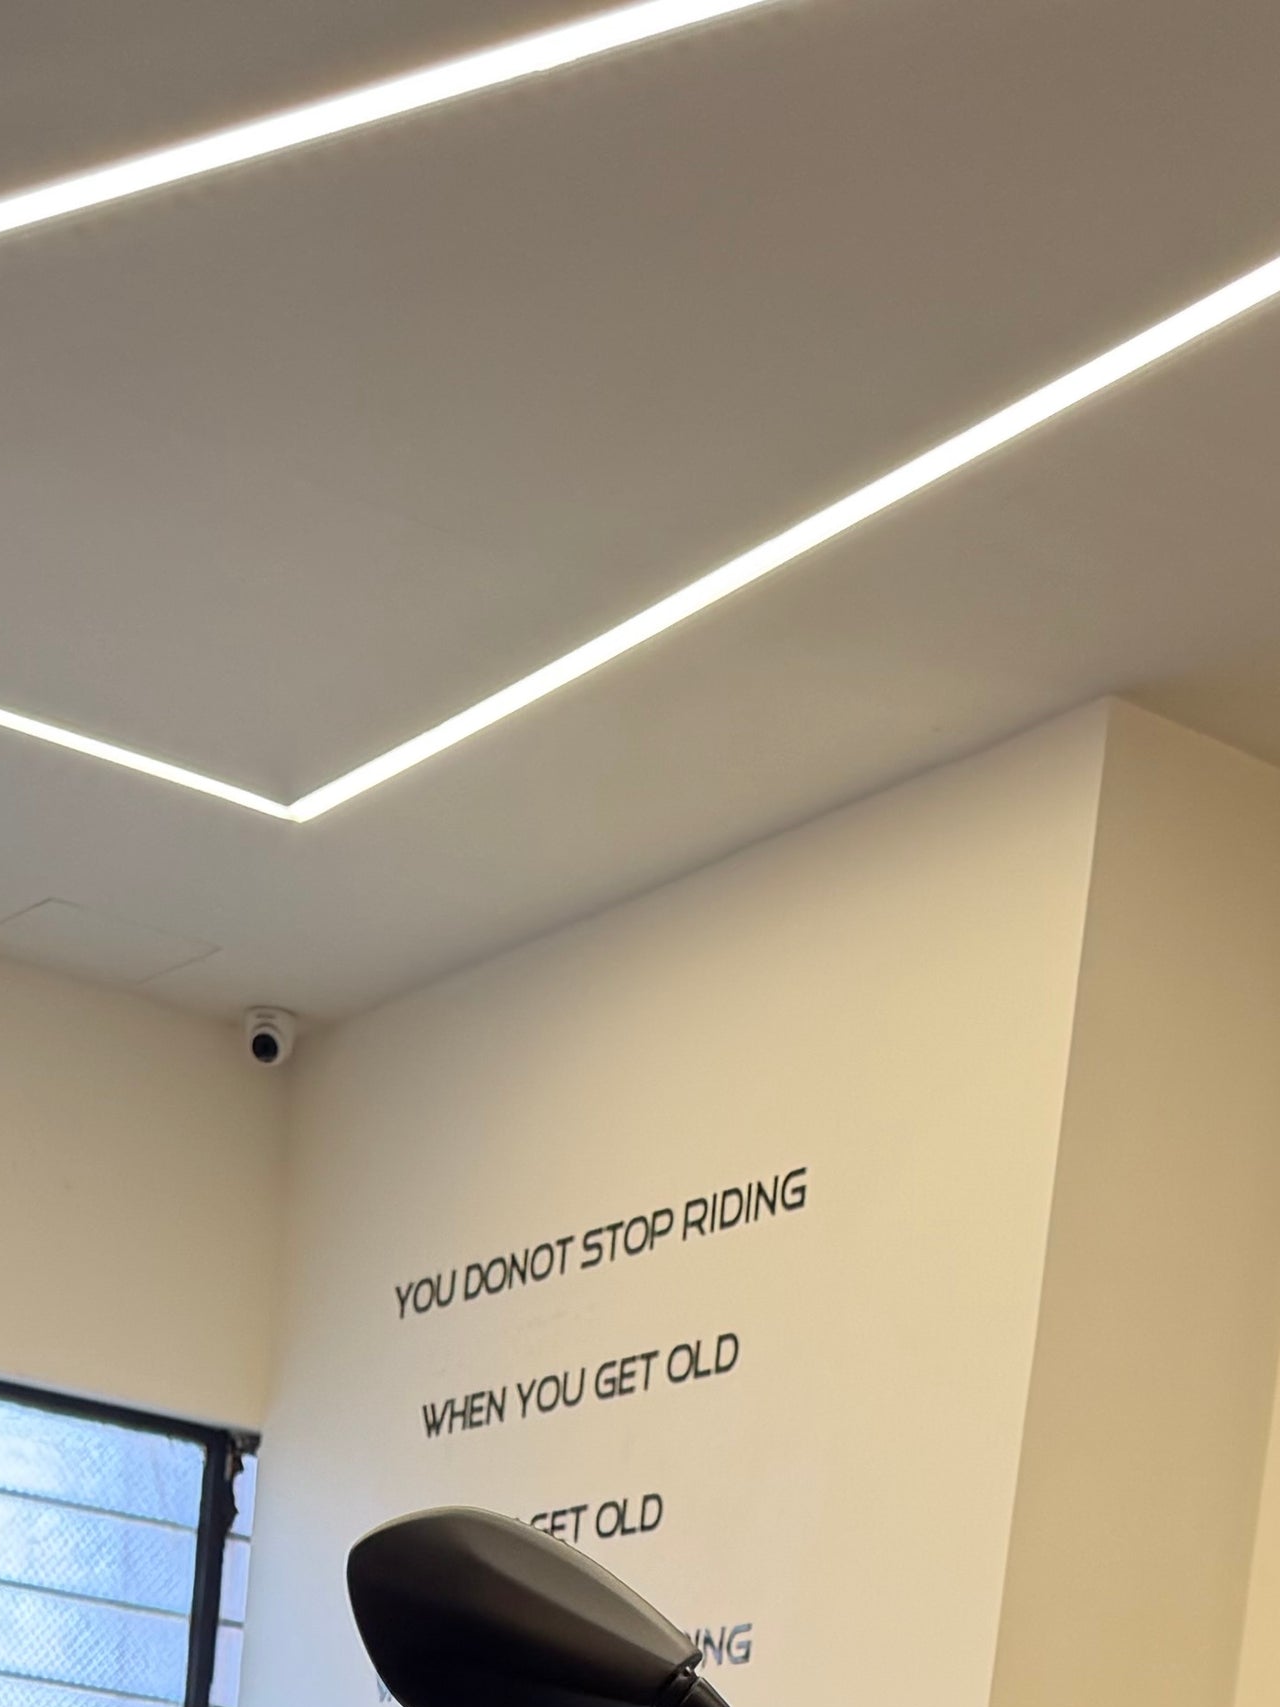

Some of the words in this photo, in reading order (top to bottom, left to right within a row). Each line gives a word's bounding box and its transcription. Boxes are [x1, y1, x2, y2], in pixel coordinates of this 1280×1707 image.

[395, 1269, 457, 1320] YOU
[463, 1235, 575, 1301] DONOT
[580, 1207, 674, 1269] STOP
[681, 1166, 807, 1242] RIDING
[422, 1385, 507, 1438] WHEN
[516, 1367, 586, 1418] YOU
[594, 1349, 660, 1399] GET
[666, 1332, 740, 1384] OLD
[595, 1493, 663, 1538] OLD
